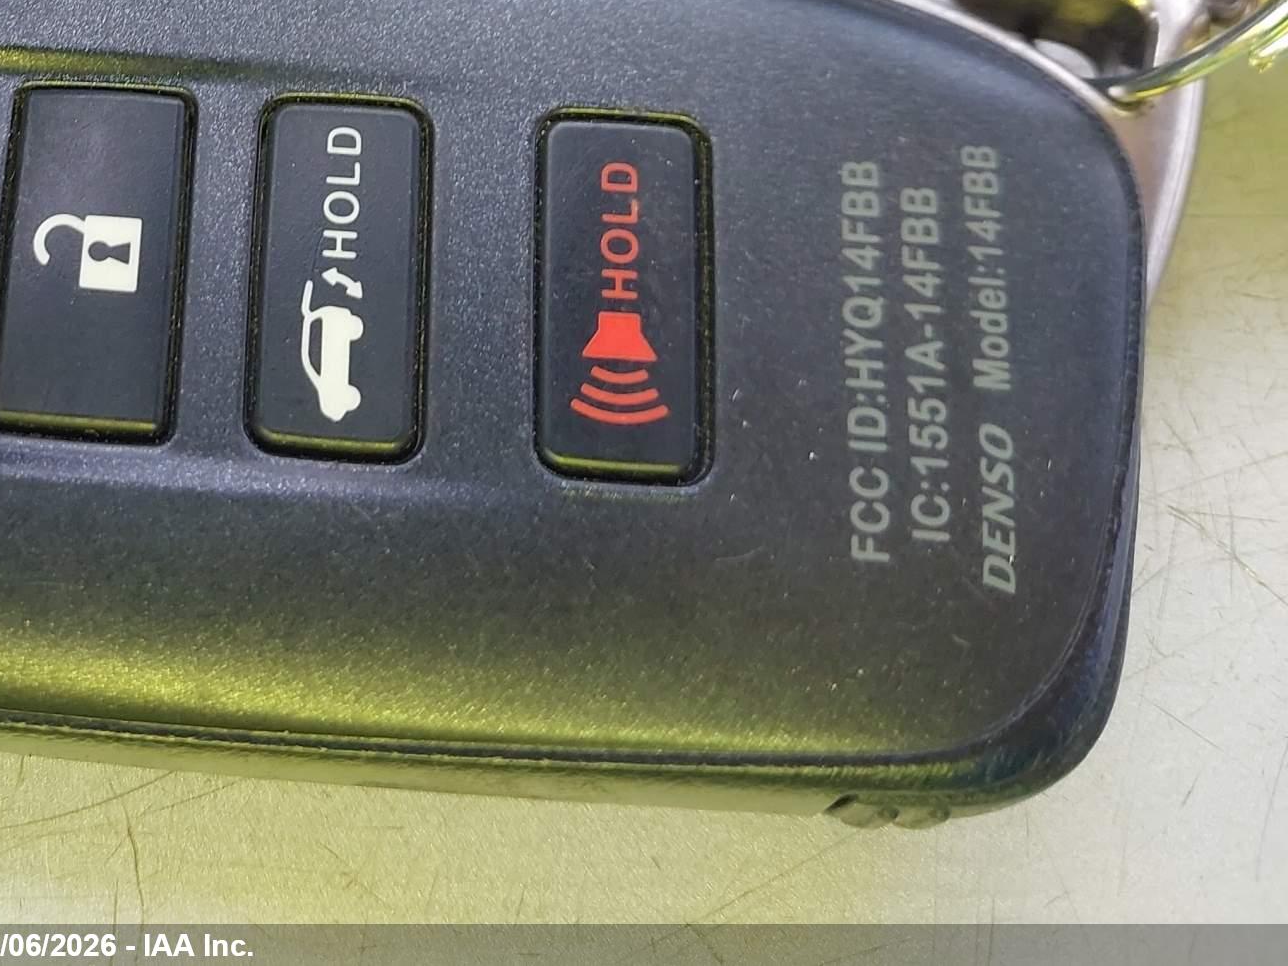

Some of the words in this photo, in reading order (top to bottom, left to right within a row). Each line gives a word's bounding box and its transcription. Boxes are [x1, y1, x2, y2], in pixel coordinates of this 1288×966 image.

[321, 126, 363, 260] HOLD
[599, 160, 640, 301] HOLD
[961, 145, 1011, 391] Model:14FBB
[841, 160, 888, 453] ID:HYQ14FBB
[900, 187, 951, 542] IC:1551A-14FBB
[849, 466, 891, 563] FCC
[978, 422, 1017, 594] DENSO
